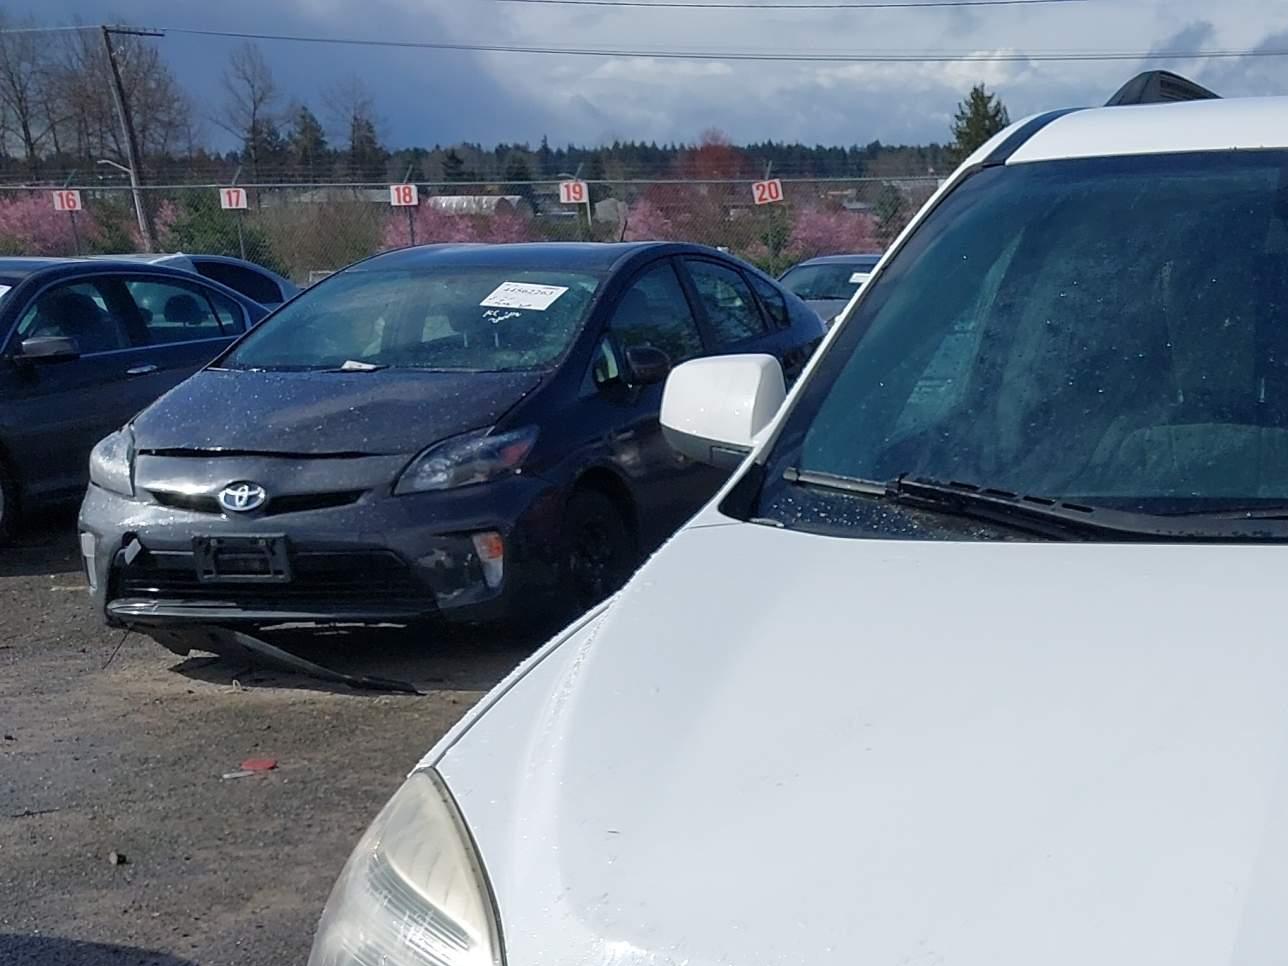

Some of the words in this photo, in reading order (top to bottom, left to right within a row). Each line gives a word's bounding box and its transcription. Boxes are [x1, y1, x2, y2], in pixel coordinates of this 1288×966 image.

[58, 191, 76, 209] 16
[226, 189, 240, 207] 17
[394, 186, 412, 204] 18
[564, 183, 582, 201] 19
[756, 181, 779, 202] 20
